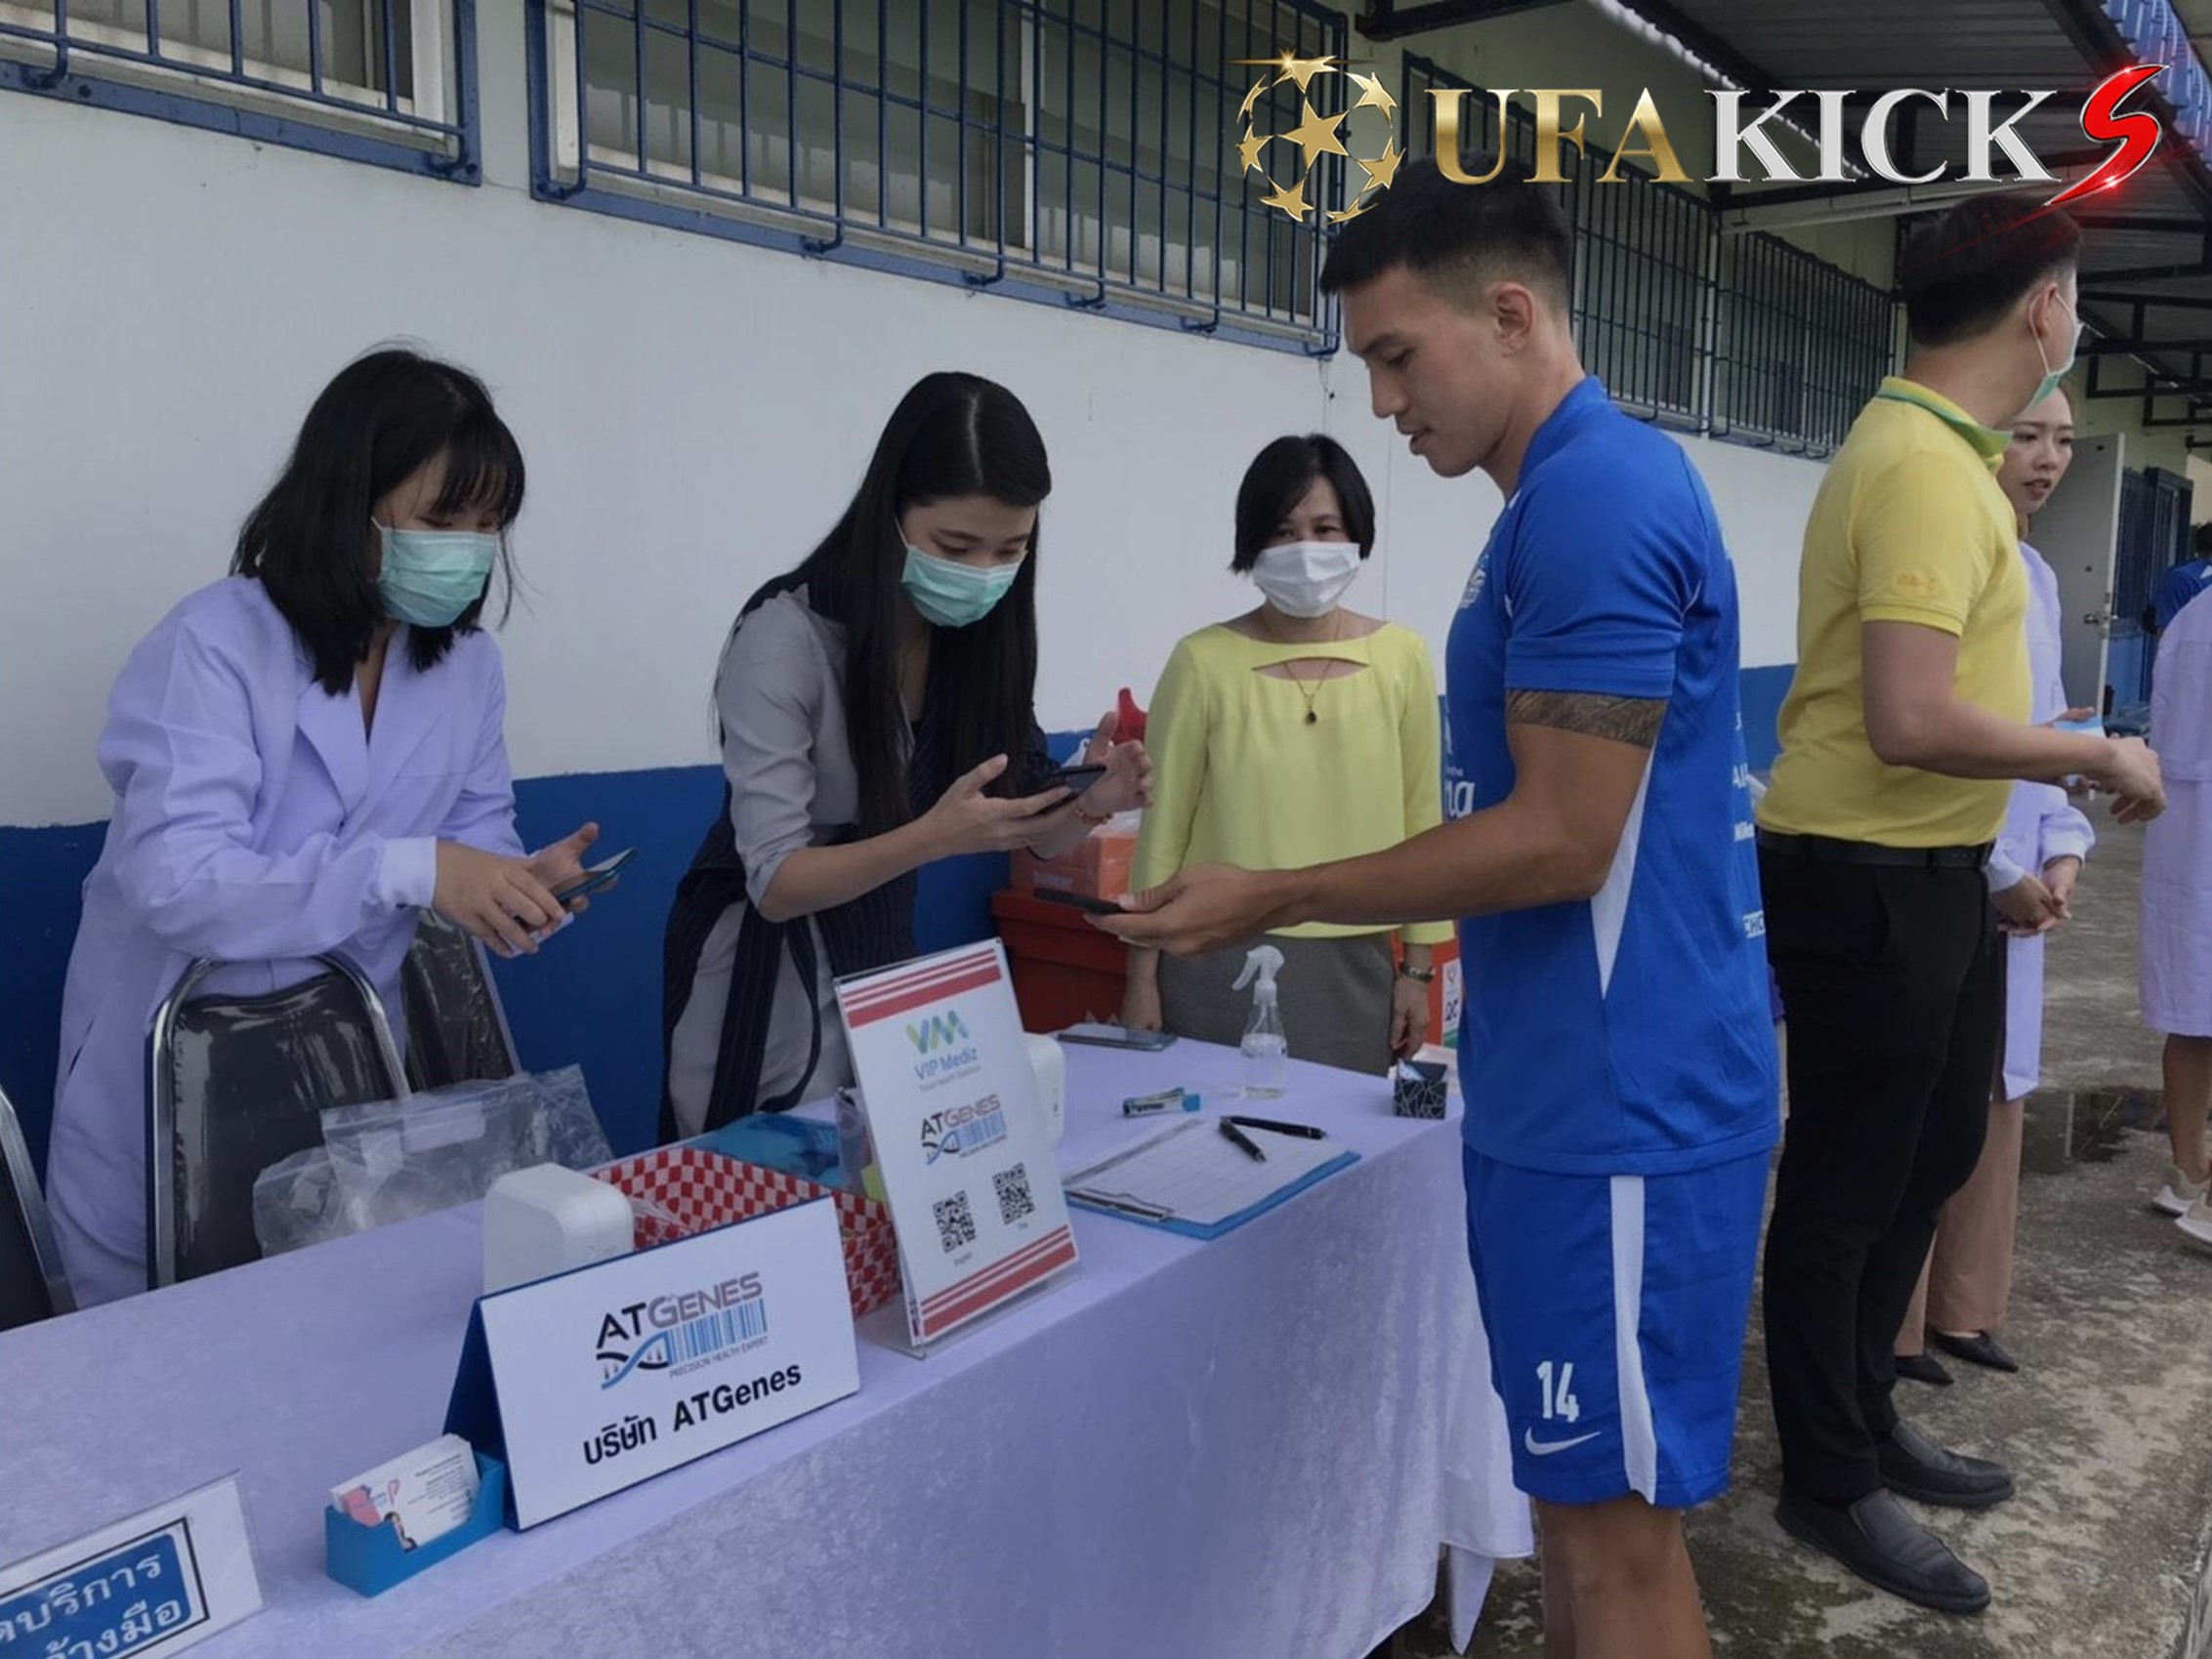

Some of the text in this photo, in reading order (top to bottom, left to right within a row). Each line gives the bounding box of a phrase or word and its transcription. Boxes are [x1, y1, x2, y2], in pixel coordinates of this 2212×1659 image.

[914, 1058, 938, 1080] VIP
[939, 1048, 978, 1071] Mediz
[921, 1093, 1001, 1141] ATGENES
[596, 1271, 763, 1349] ATGENES
[583, 1364, 802, 1465] บริษัท ATGenes
[1536, 1360, 1580, 1423] 14
